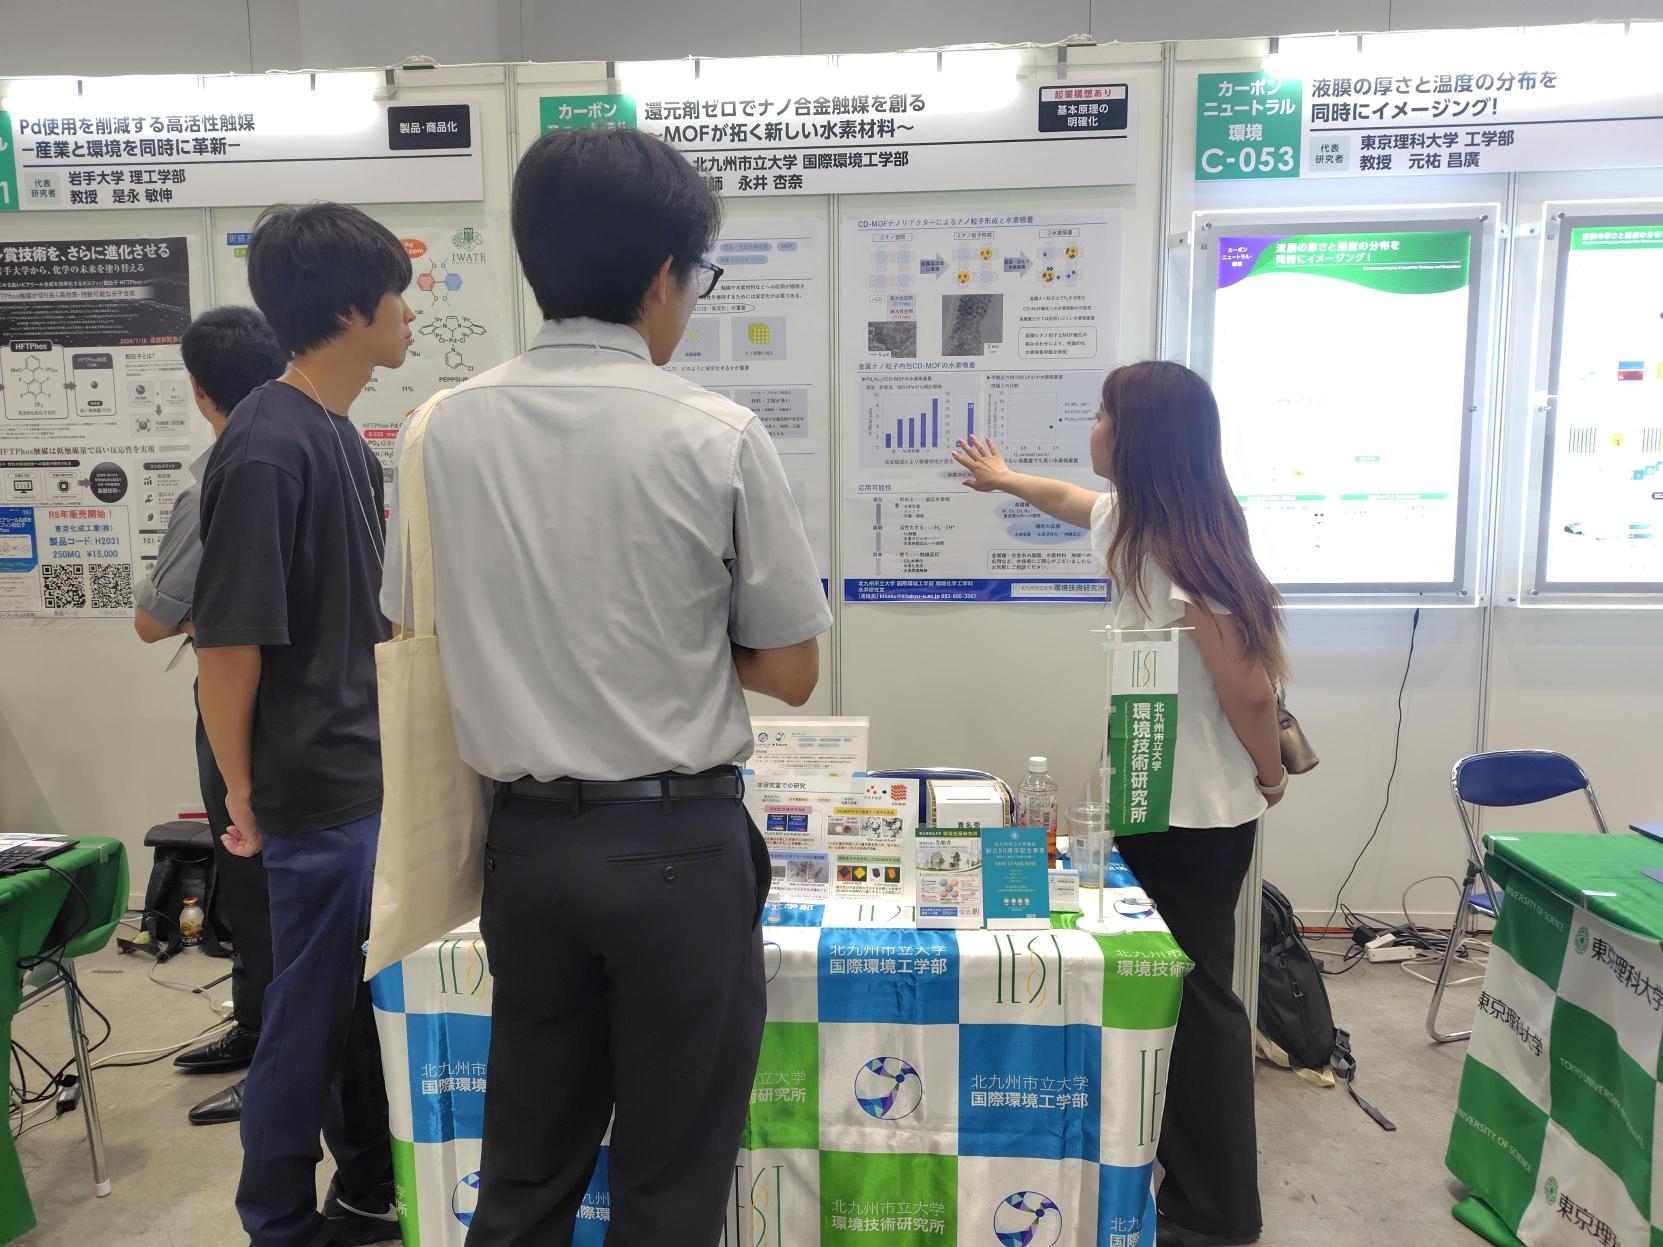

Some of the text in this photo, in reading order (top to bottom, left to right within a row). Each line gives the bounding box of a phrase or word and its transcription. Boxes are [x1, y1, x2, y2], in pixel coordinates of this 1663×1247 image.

[1054, 88, 1112, 99] 起業構想あり
[1217, 80, 1284, 97] カーボン
[1311, 71, 1558, 99] 液膜の厚さと温度の分布を
[558, 102, 618, 120] カーボン
[644, 94, 926, 121] 還元剤ゼロでナノ合金触媒を創る
[1057, 103, 1109, 116] 基本原理の
[1203, 98, 1297, 117] ニュートラル
[19, 113, 256, 136] Pd使用を削減する高活性触媒
[399, 121, 459, 134] 製品・商品化
[1066, 116, 1099, 127] 明確化
[1228, 123, 1263, 142] 環境
[1360, 130, 1515, 151] 東京理科大学 工学部
[1319, 144, 1340, 154] 代表
[693, 150, 909, 172] 北九州市立大学 国際環境工学部
[1201, 145, 1296, 174] C-053
[1314, 154, 1345, 165] 研究者
[1360, 154, 1393, 171] 教授
[1408, 153, 1441, 169] 元祐
[34, 178, 51, 188] 代表
[68, 168, 186, 186] 岩手大学 理工学部
[738, 174, 768, 191] 永井
[773, 174, 803, 190] 杏奈
[31, 188, 56, 198] 研究者
[70, 187, 173, 205] 教授 是永 敏伸
[0, 242, 170, 263] 賞技術を、さらに進化させる
[452, 253, 487, 262] IWATE
[15, 342, 48, 350] HFTPhos
[95, 537, 120, 545] H2031
[87, 550, 119, 558] ¥15,000
[1053, 583, 1105, 592] 環境技術研究所
[1131, 650, 1158, 687] IEST
[1151, 701, 1165, 772] 北九州市立大学
[1131, 702, 1151, 824] 環境技術研究所
[757, 782, 807, 790] 本研究室での研究
[829, 958, 948, 976] 国際環境工学部
[993, 934, 1063, 1007] IEST
[1591, 937, 1663, 1013] 東京理科大学
[1476, 989, 1544, 1058] 東京理科大学
[970, 1073, 1090, 1092] 北九州市立大学
[970, 1091, 1090, 1110] 国際環境工学部
[1497, 1136, 1509, 1149] OF
[831, 1199, 945, 1217] 北九州市立大学
[831, 1215, 945, 1236] 環境技術研究所
